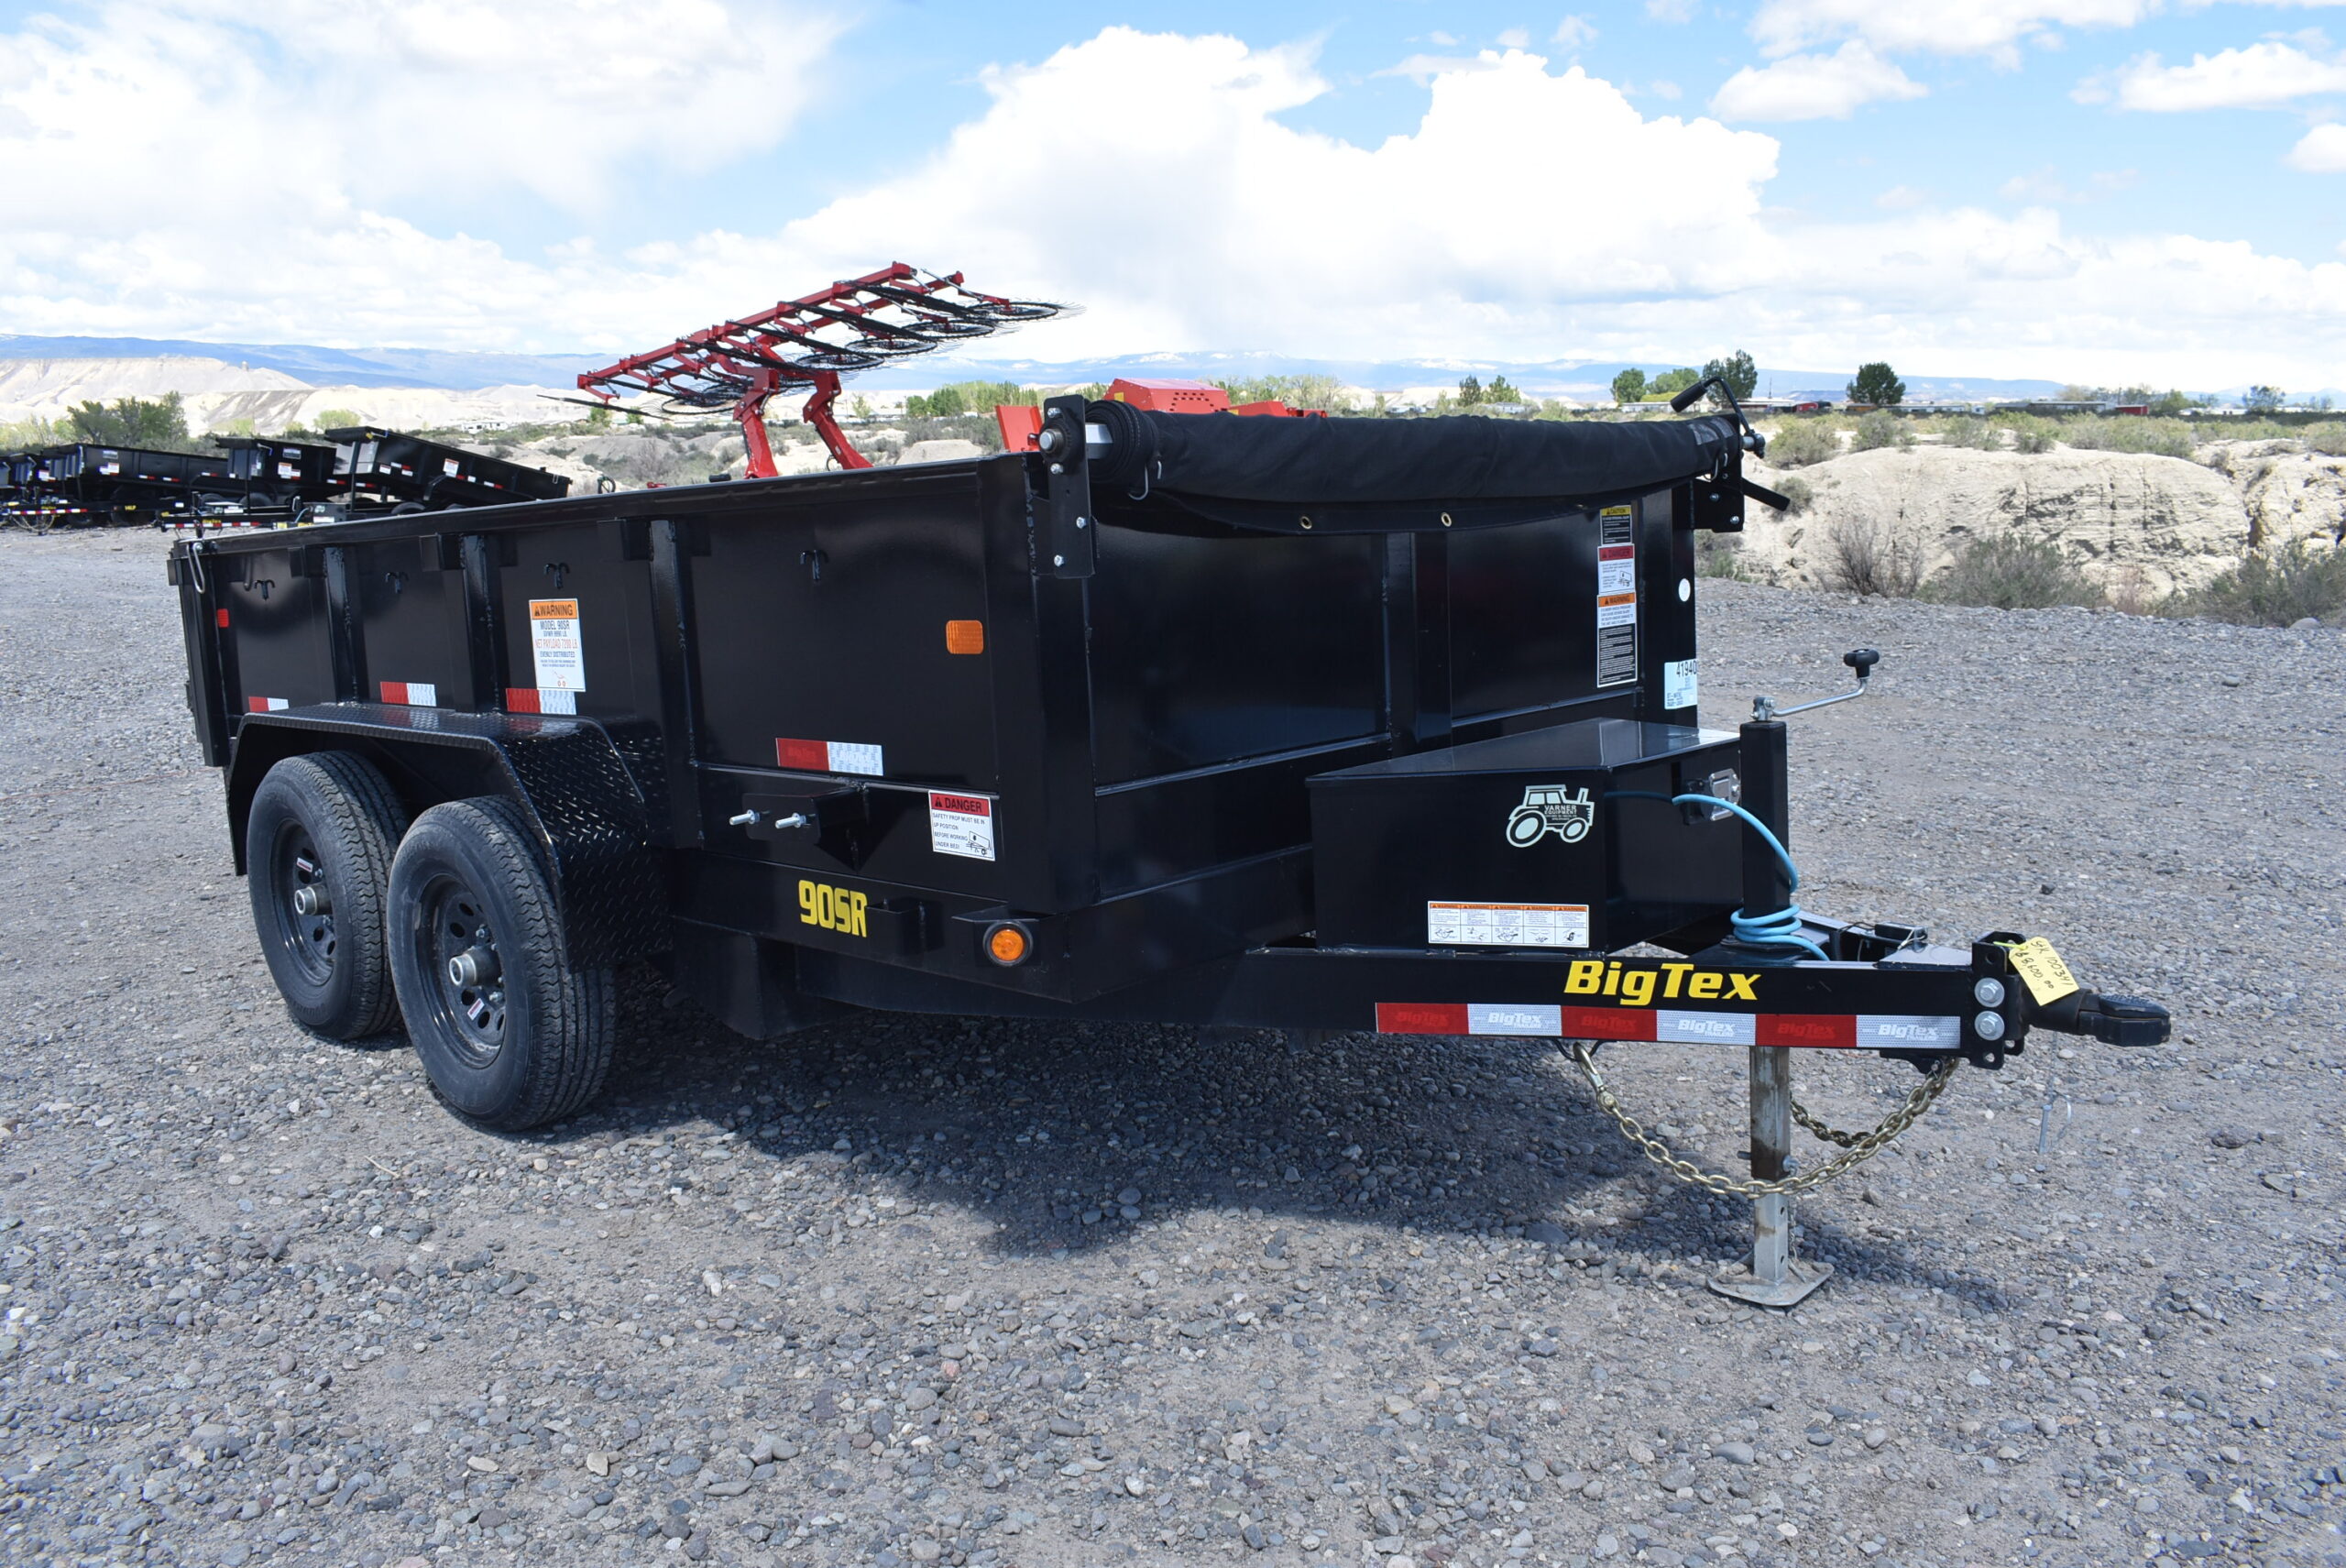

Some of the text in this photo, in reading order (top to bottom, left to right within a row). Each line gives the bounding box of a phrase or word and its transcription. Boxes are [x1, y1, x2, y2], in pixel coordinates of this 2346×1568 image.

[539, 604, 574, 617] WARNING
[540, 620, 556, 630] MODEL
[543, 639, 561, 649] PAYLOAD
[944, 797, 982, 813] DANGER
[939, 822, 959, 830] POSITION
[949, 833, 969, 841] WORKING
[798, 880, 868, 938] 90SR
[1563, 960, 1761, 1006] BigTex
[1396, 1011, 1449, 1025] BigTex
[1488, 1012, 1541, 1026] BigTex
[1581, 1014, 1638, 1030] BigTex
[1677, 1019, 1736, 1034] BigTex
[1777, 1023, 1836, 1036] BigTex
[1878, 1025, 1938, 1038] BigTex
